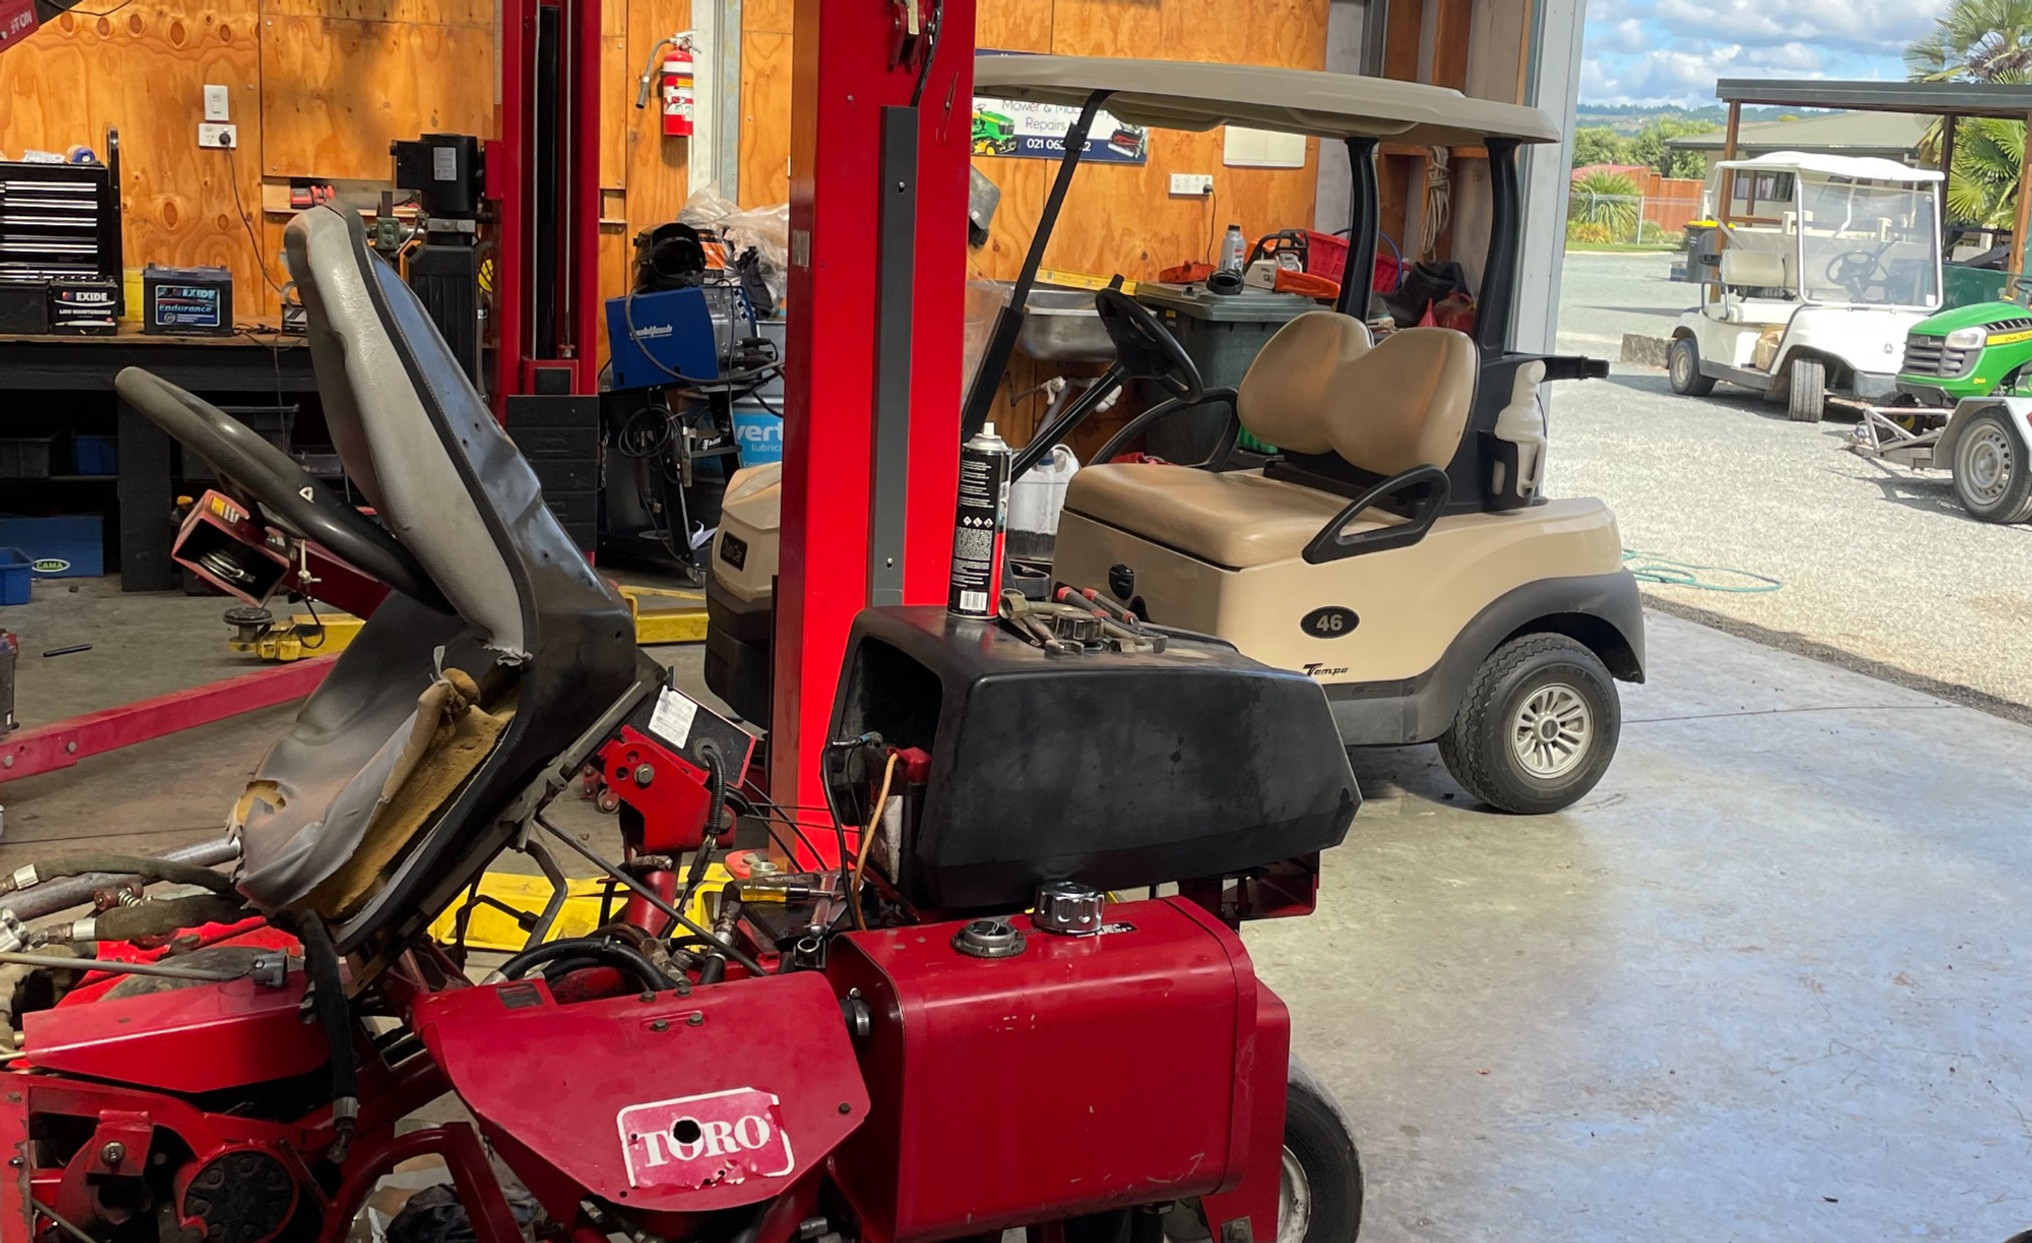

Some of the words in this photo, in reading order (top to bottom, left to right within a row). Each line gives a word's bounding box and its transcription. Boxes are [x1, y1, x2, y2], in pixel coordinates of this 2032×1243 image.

[1025, 116, 1066, 133] Repairs
[1026, 138, 1044, 149] 021
[76, 292, 107, 301] EXIDE
[183, 289, 216, 298] EXIDE
[159, 304, 212, 313] Endurance
[1316, 613, 1343, 632] 46
[1303, 662, 1349, 677] Tempo
[637, 1115, 771, 1168] TORO
